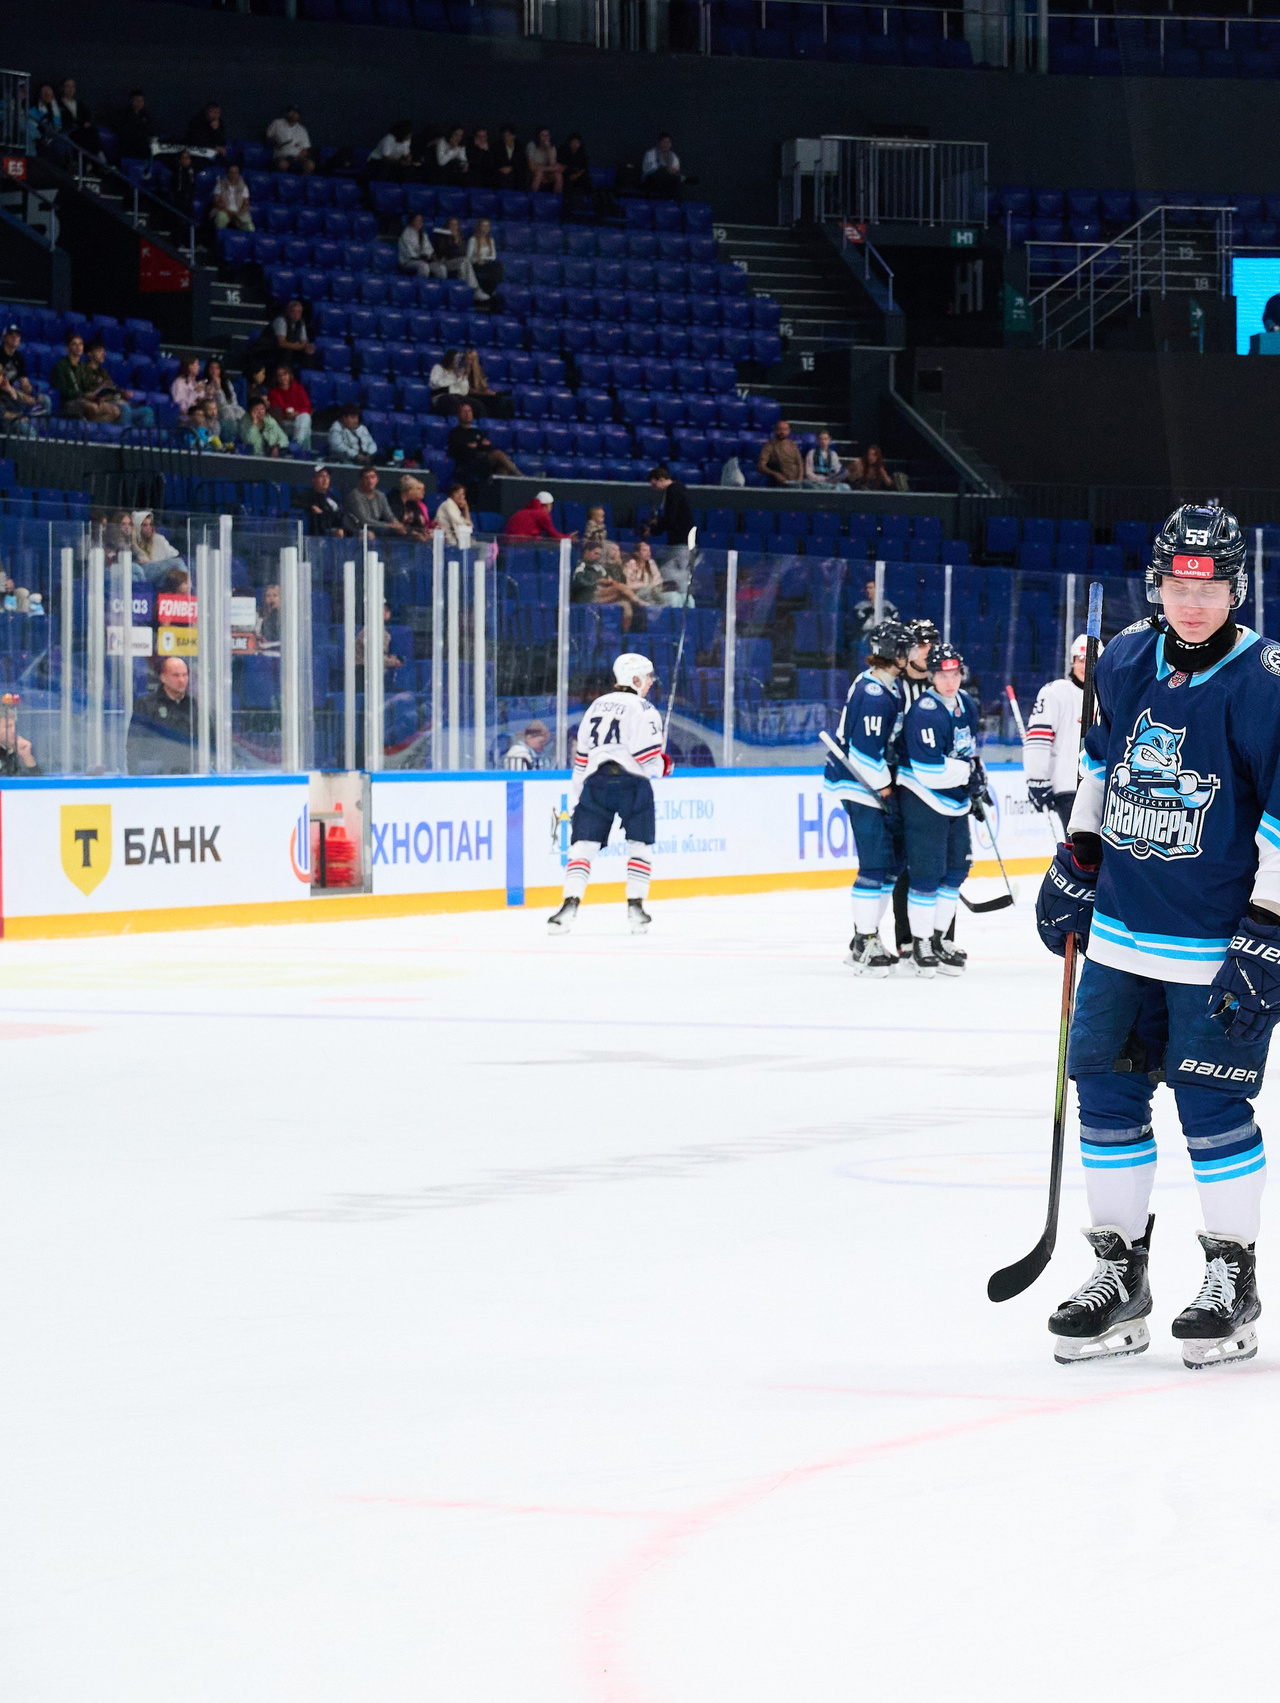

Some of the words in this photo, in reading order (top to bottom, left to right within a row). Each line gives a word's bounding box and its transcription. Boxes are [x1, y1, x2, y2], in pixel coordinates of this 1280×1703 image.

[956, 231, 973, 244] H1
[226, 290, 241, 305] 16
[1185, 529, 1209, 546] 53
[1174, 569, 1212, 578] OLIMPBET
[863, 715, 883, 737] 14
[920, 728, 936, 748] 4
[1122, 791, 1178, 808] СИБИРСКИЕ
[123, 825, 222, 867] БАНК
[371, 820, 493, 865] ХНОПАН
[1048, 863, 1096, 902] BAUE
[1178, 1058, 1259, 1084] BAUER
